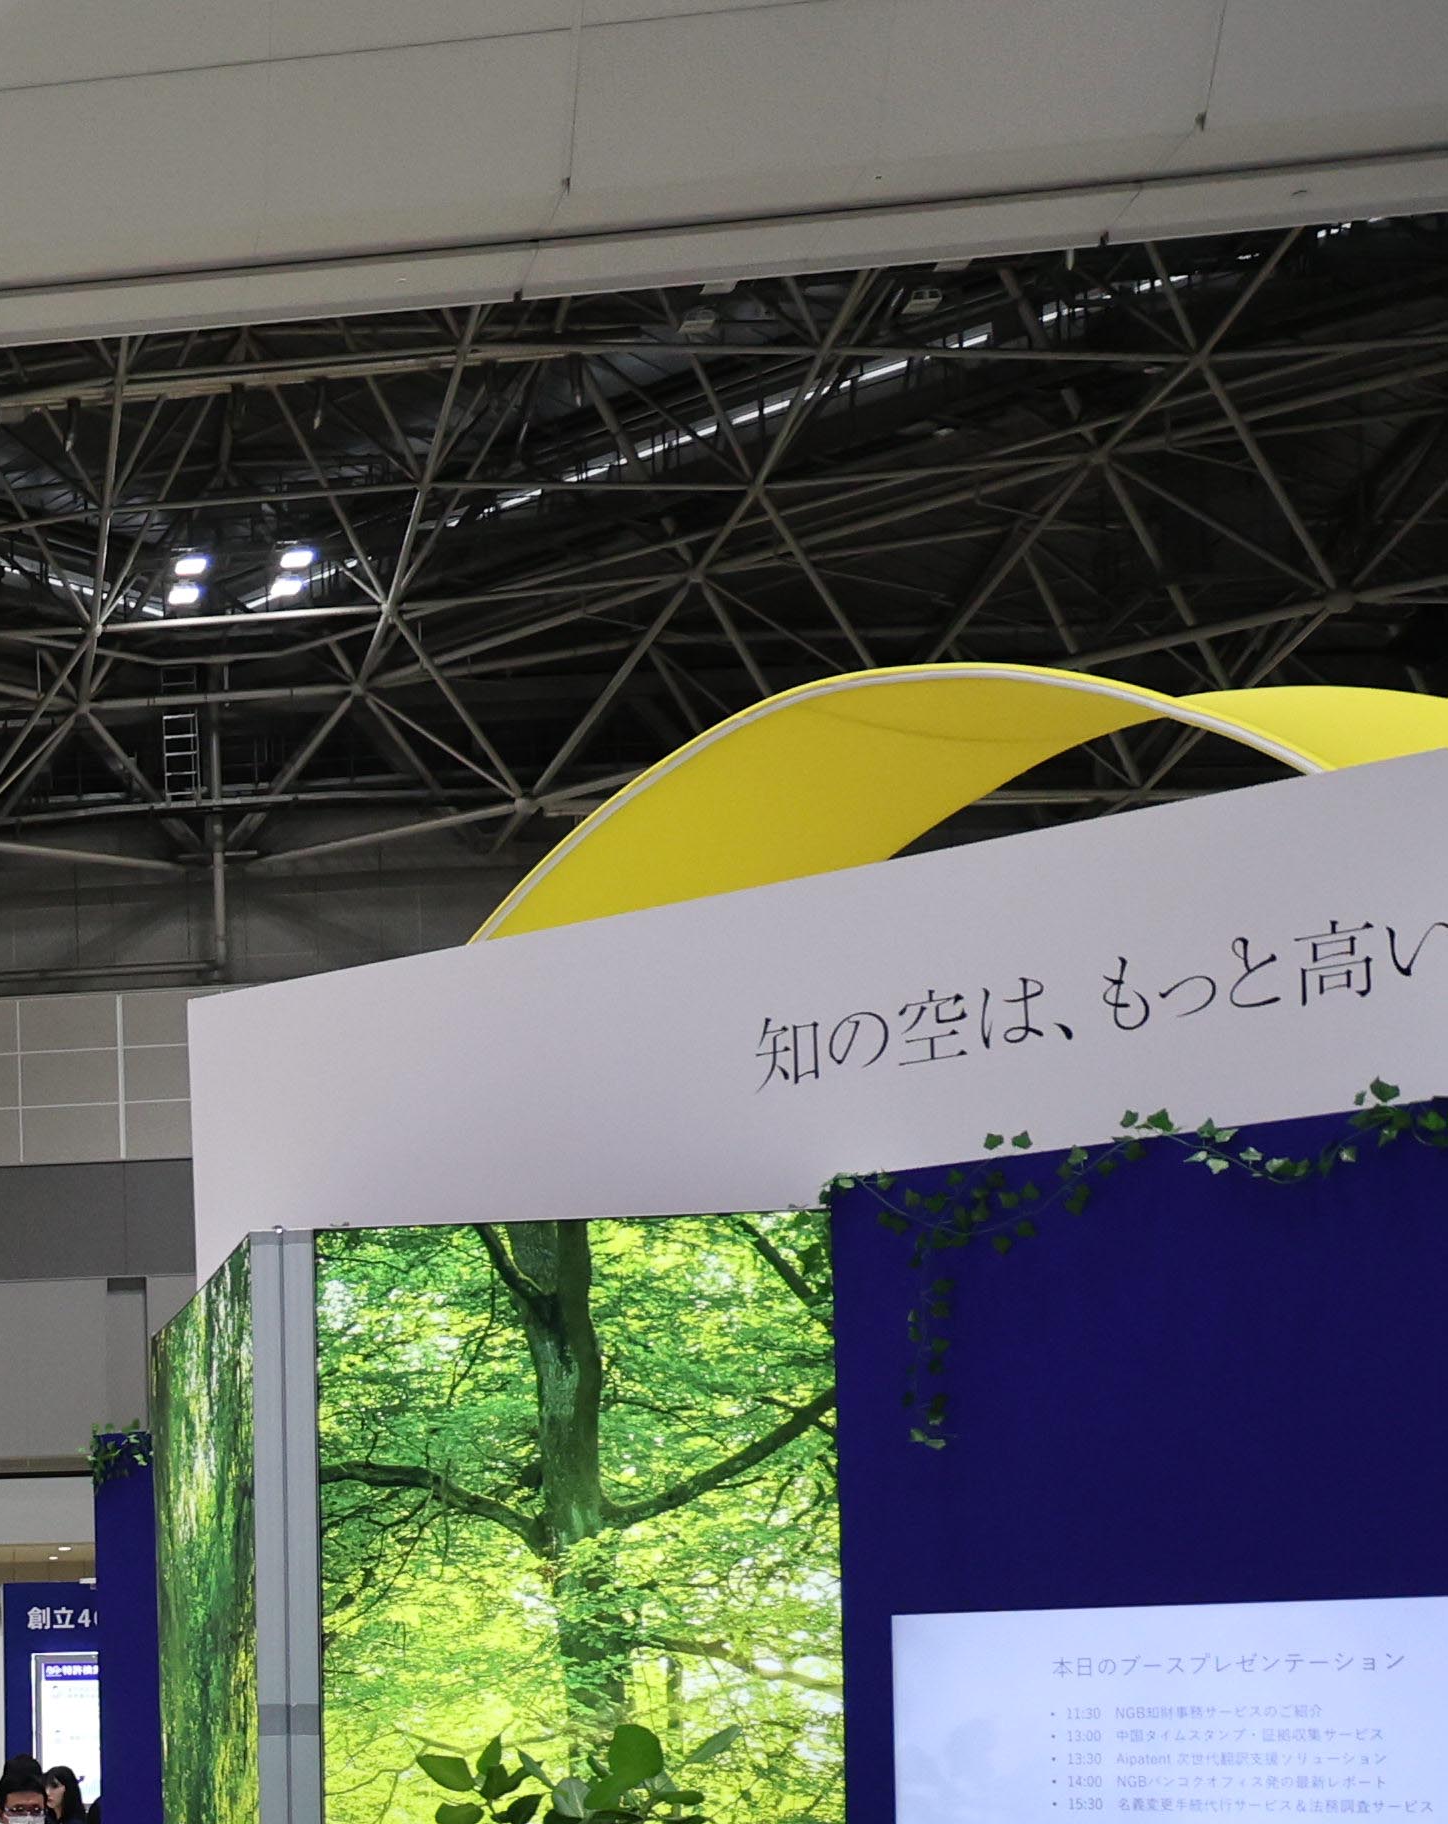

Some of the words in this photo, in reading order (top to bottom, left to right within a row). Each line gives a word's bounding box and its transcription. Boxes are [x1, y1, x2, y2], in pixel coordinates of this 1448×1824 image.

[1051, 1651, 1406, 1679] 本日のブースプレゼンテーション
